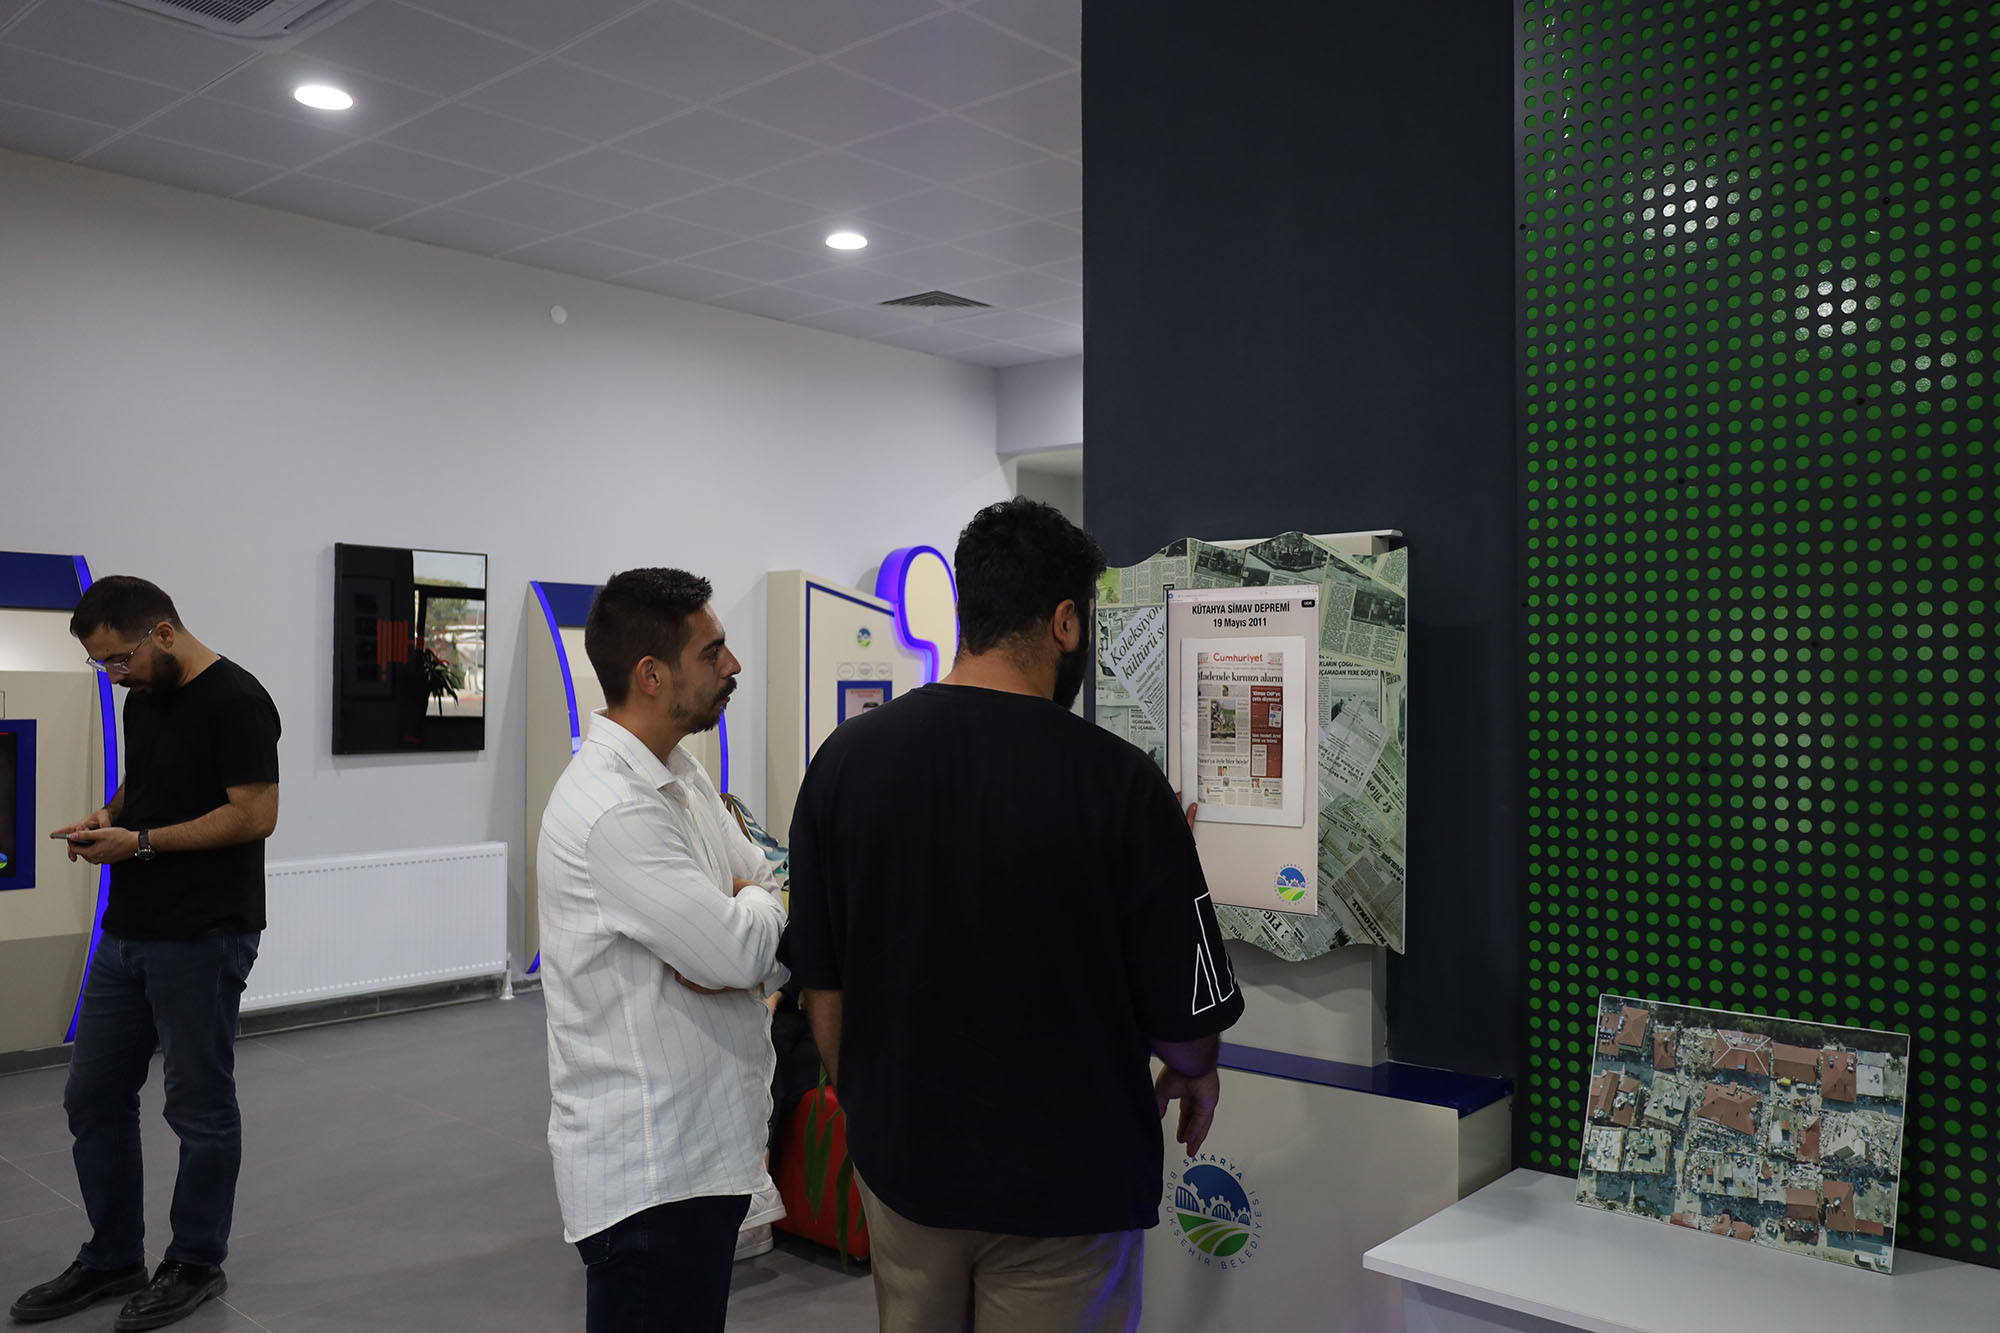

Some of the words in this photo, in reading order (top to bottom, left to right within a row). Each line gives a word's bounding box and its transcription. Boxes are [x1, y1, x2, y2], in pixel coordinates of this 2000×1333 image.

[1192, 604, 1225, 615] KÜTAHYA
[1228, 602, 1252, 614] SİMAV
[1254, 601, 1290, 613] DEPREMİ
[1213, 618, 1223, 627] 19
[1224, 618, 1247, 628] Mayıs
[1248, 617, 1267, 627] 2011
[1213, 652, 1263, 663] Cumhuriyet
[1183, 1153, 1243, 1181] SAKARYA
